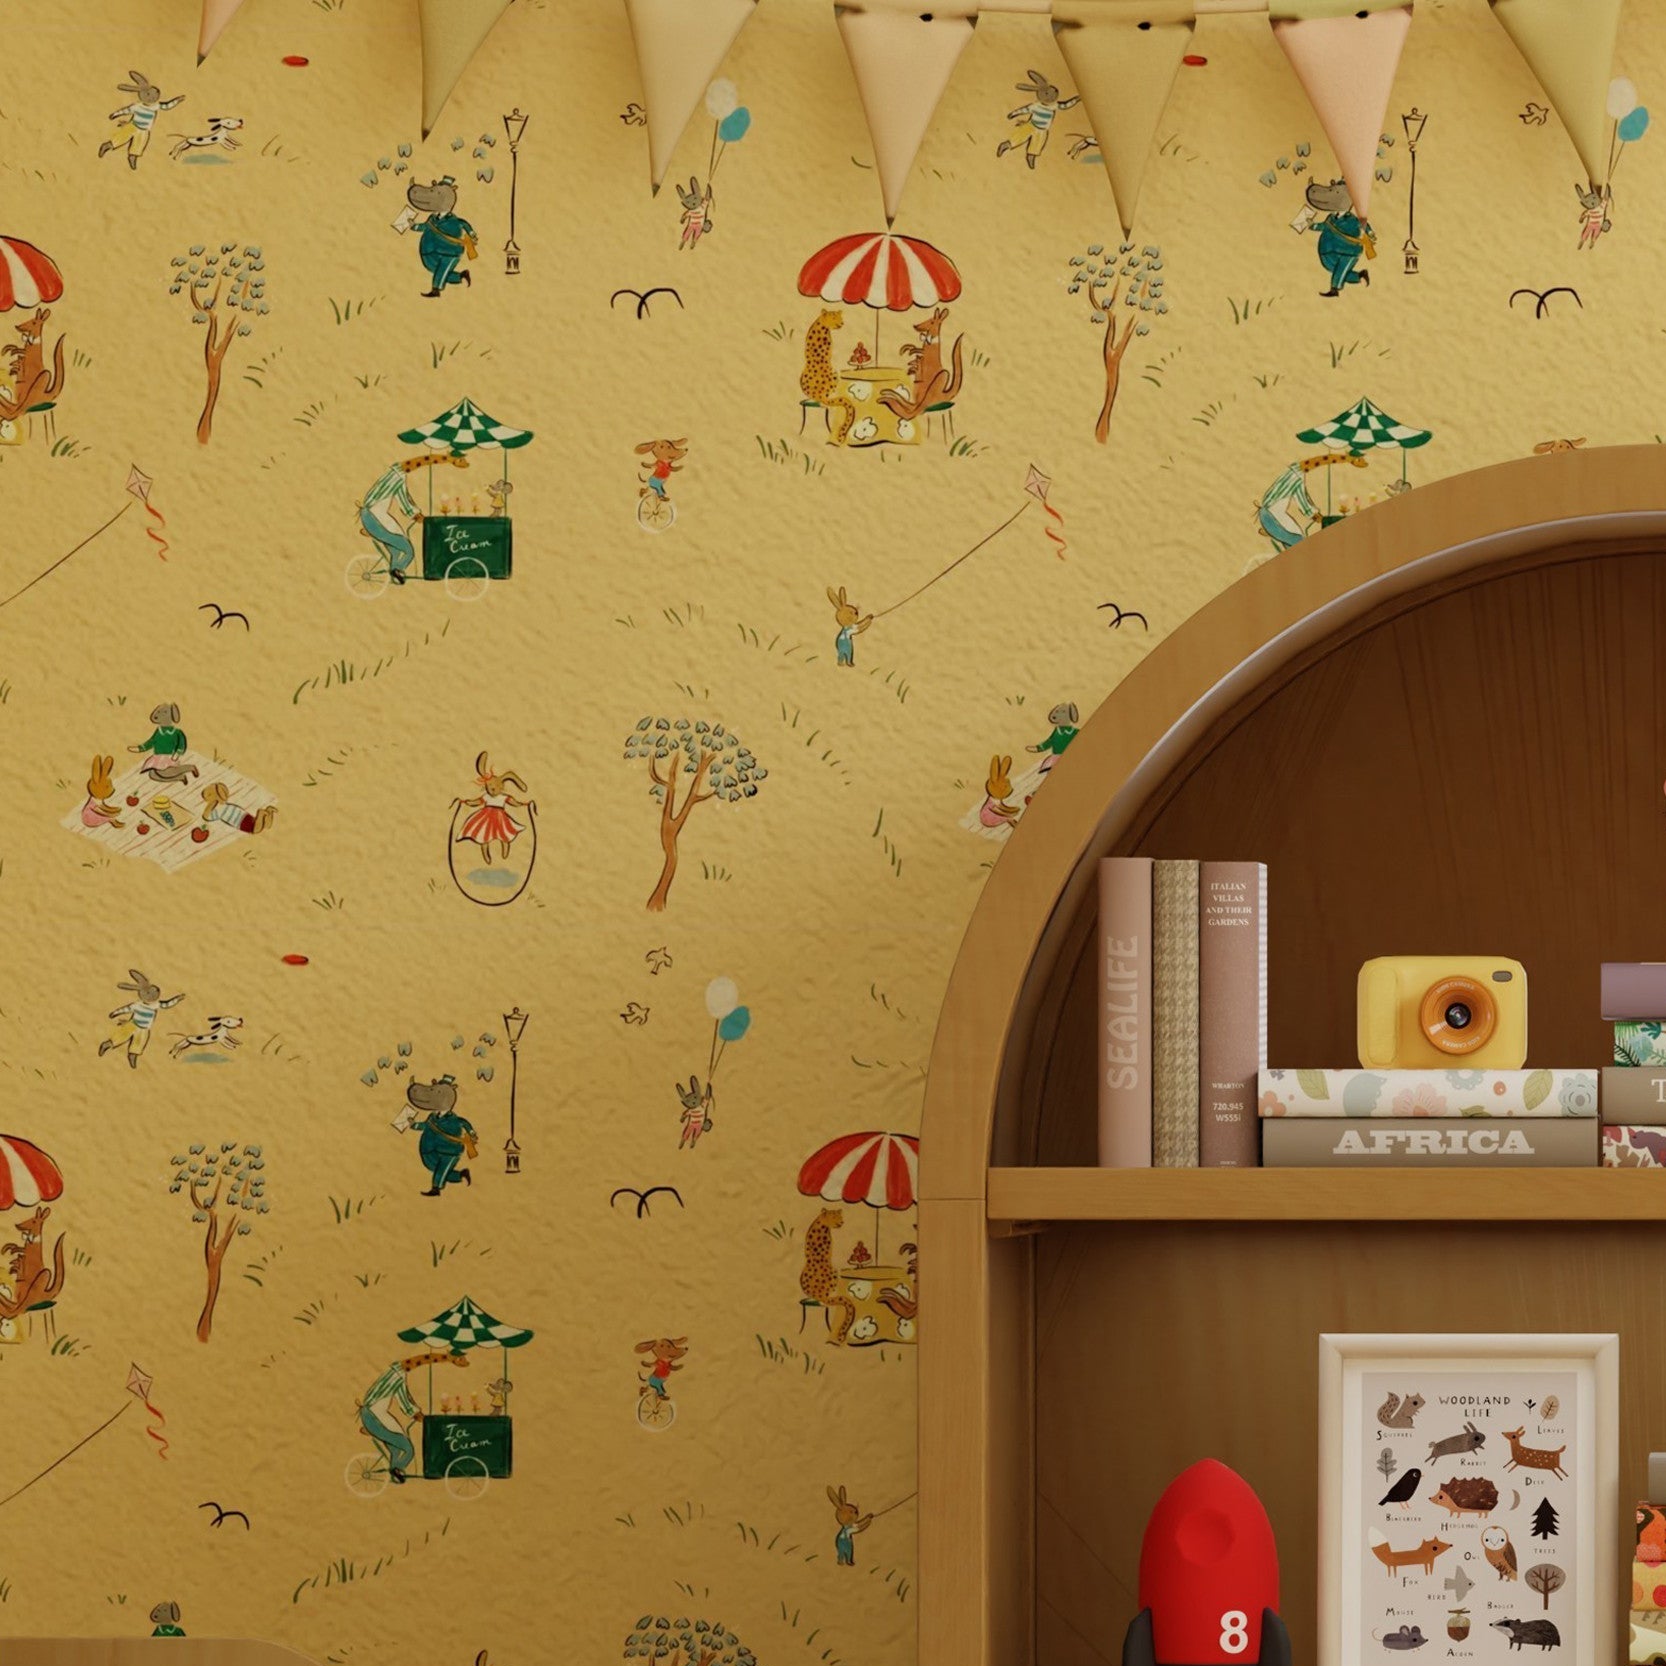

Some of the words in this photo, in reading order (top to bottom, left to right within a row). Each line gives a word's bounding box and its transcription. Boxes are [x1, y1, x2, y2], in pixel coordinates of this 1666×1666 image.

[444, 525, 469, 542] Ice
[449, 540, 492, 553] Cream
[1210, 882, 1247, 890] ITALIAN
[1213, 894, 1244, 902] VILLAS
[1206, 906, 1224, 914] AND
[1225, 906, 1252, 914] THEIR
[1208, 918, 1249, 926] GARDENS
[1107, 935, 1138, 1090] SEALIFE
[1212, 1102, 1244, 1110] 720.945
[1333, 1130, 1535, 1154] AFRICA
[1439, 1395, 1511, 1405] WOODLAND
[1465, 1408, 1490, 1417] LIFE
[444, 1423, 470, 1441] Ice
[449, 1439, 492, 1452] Cream
[1219, 1610, 1248, 1654] 8
